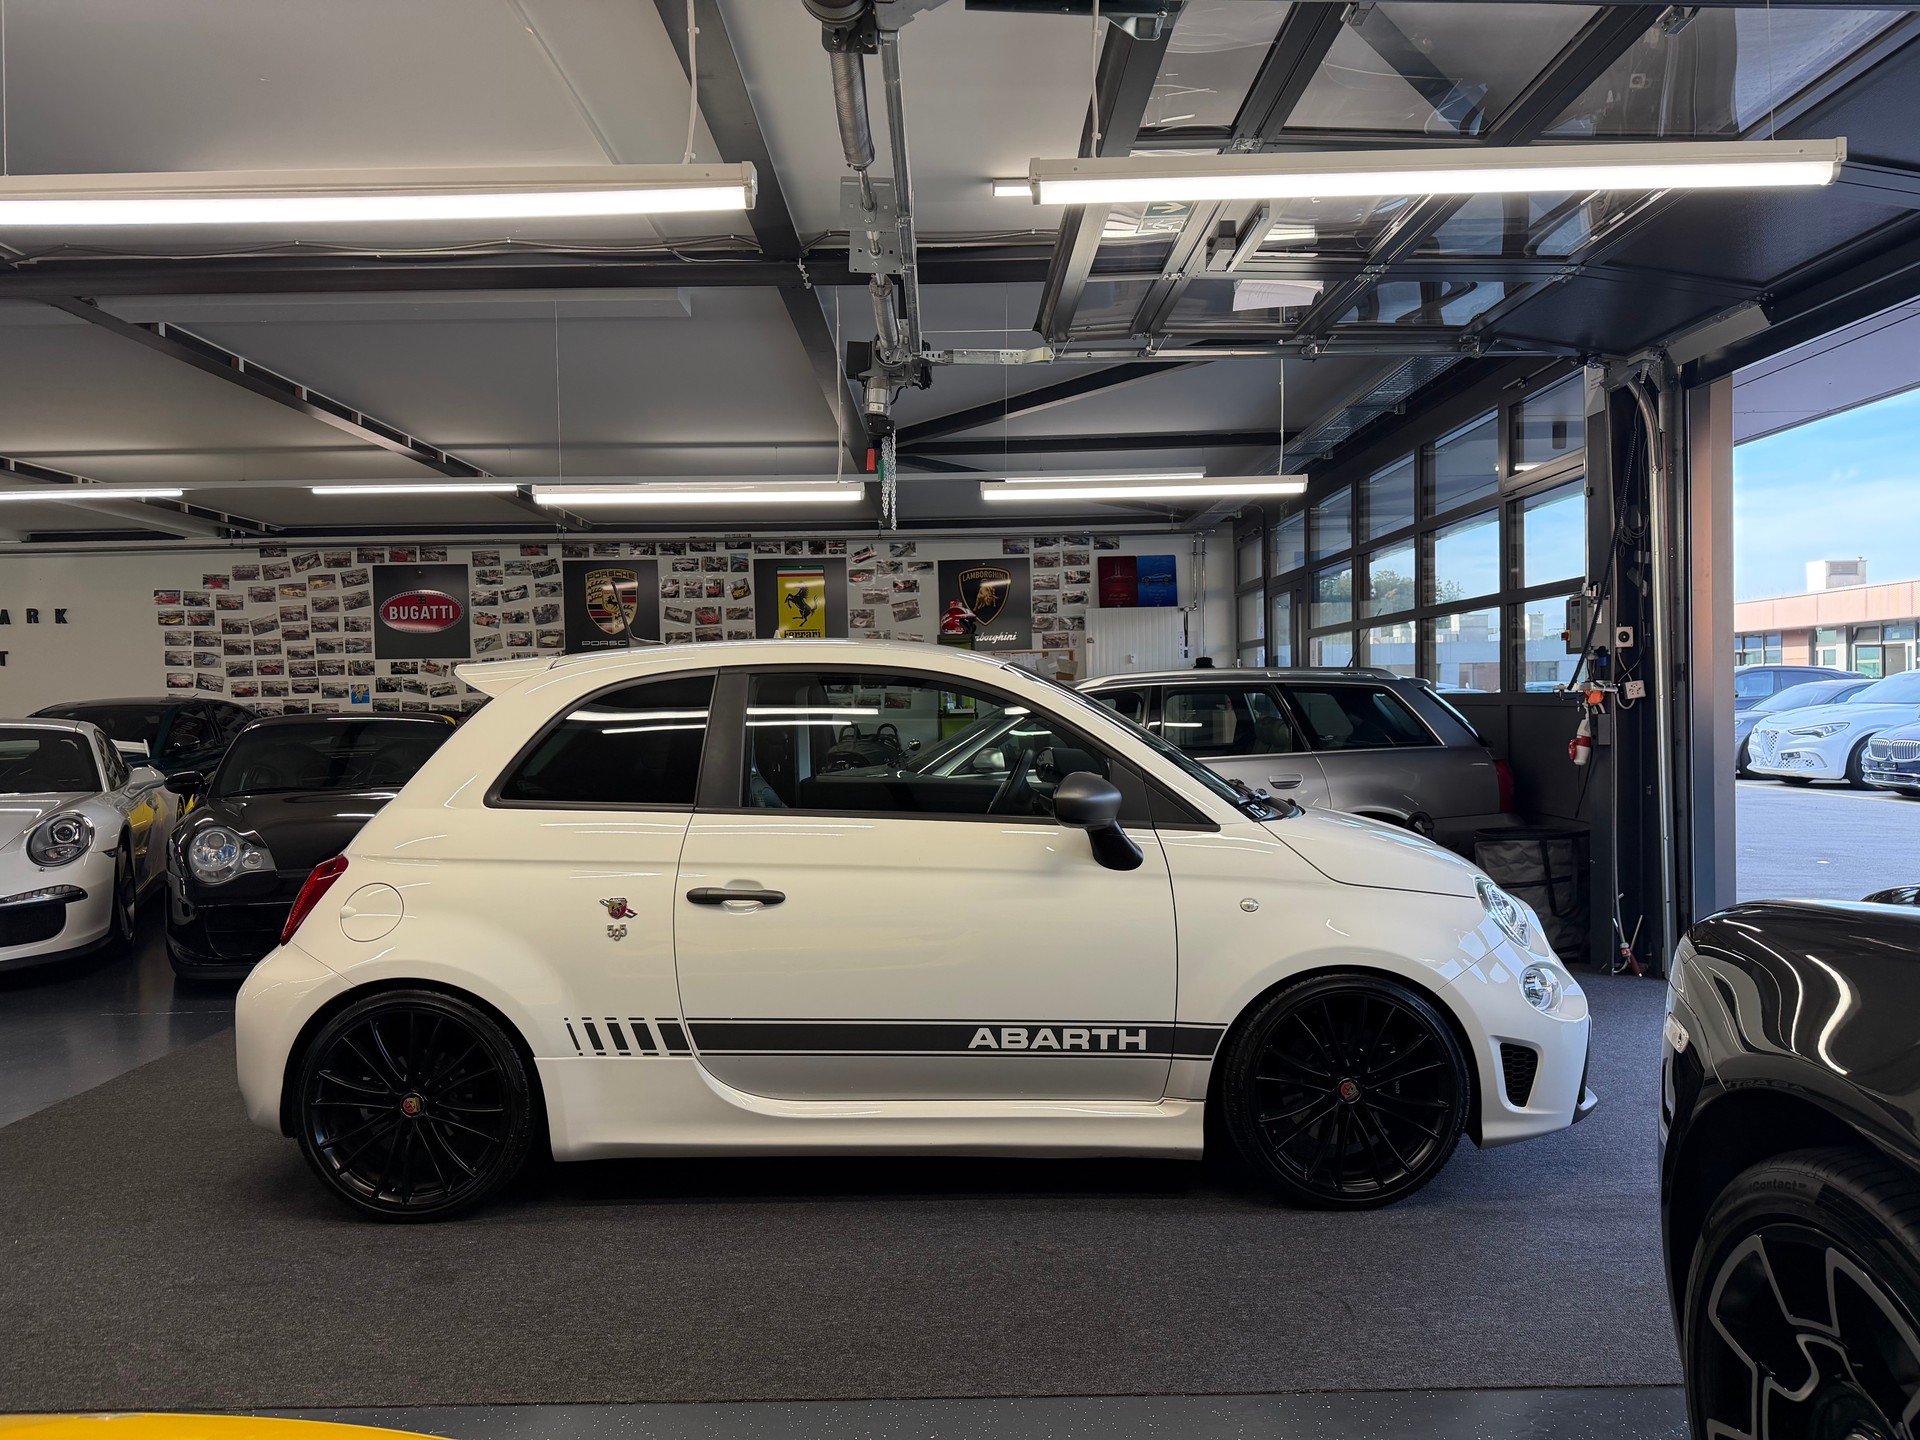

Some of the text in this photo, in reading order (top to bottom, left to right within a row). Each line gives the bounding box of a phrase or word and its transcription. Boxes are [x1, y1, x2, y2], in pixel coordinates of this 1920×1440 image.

[586, 570, 636, 580] PORSCHE
[962, 570, 1006, 582] LAMBORGHINI
[389, 605, 454, 620] BUGATTI
[606, 924, 628, 942] 595
[967, 1027, 1147, 1050] ABARTH
